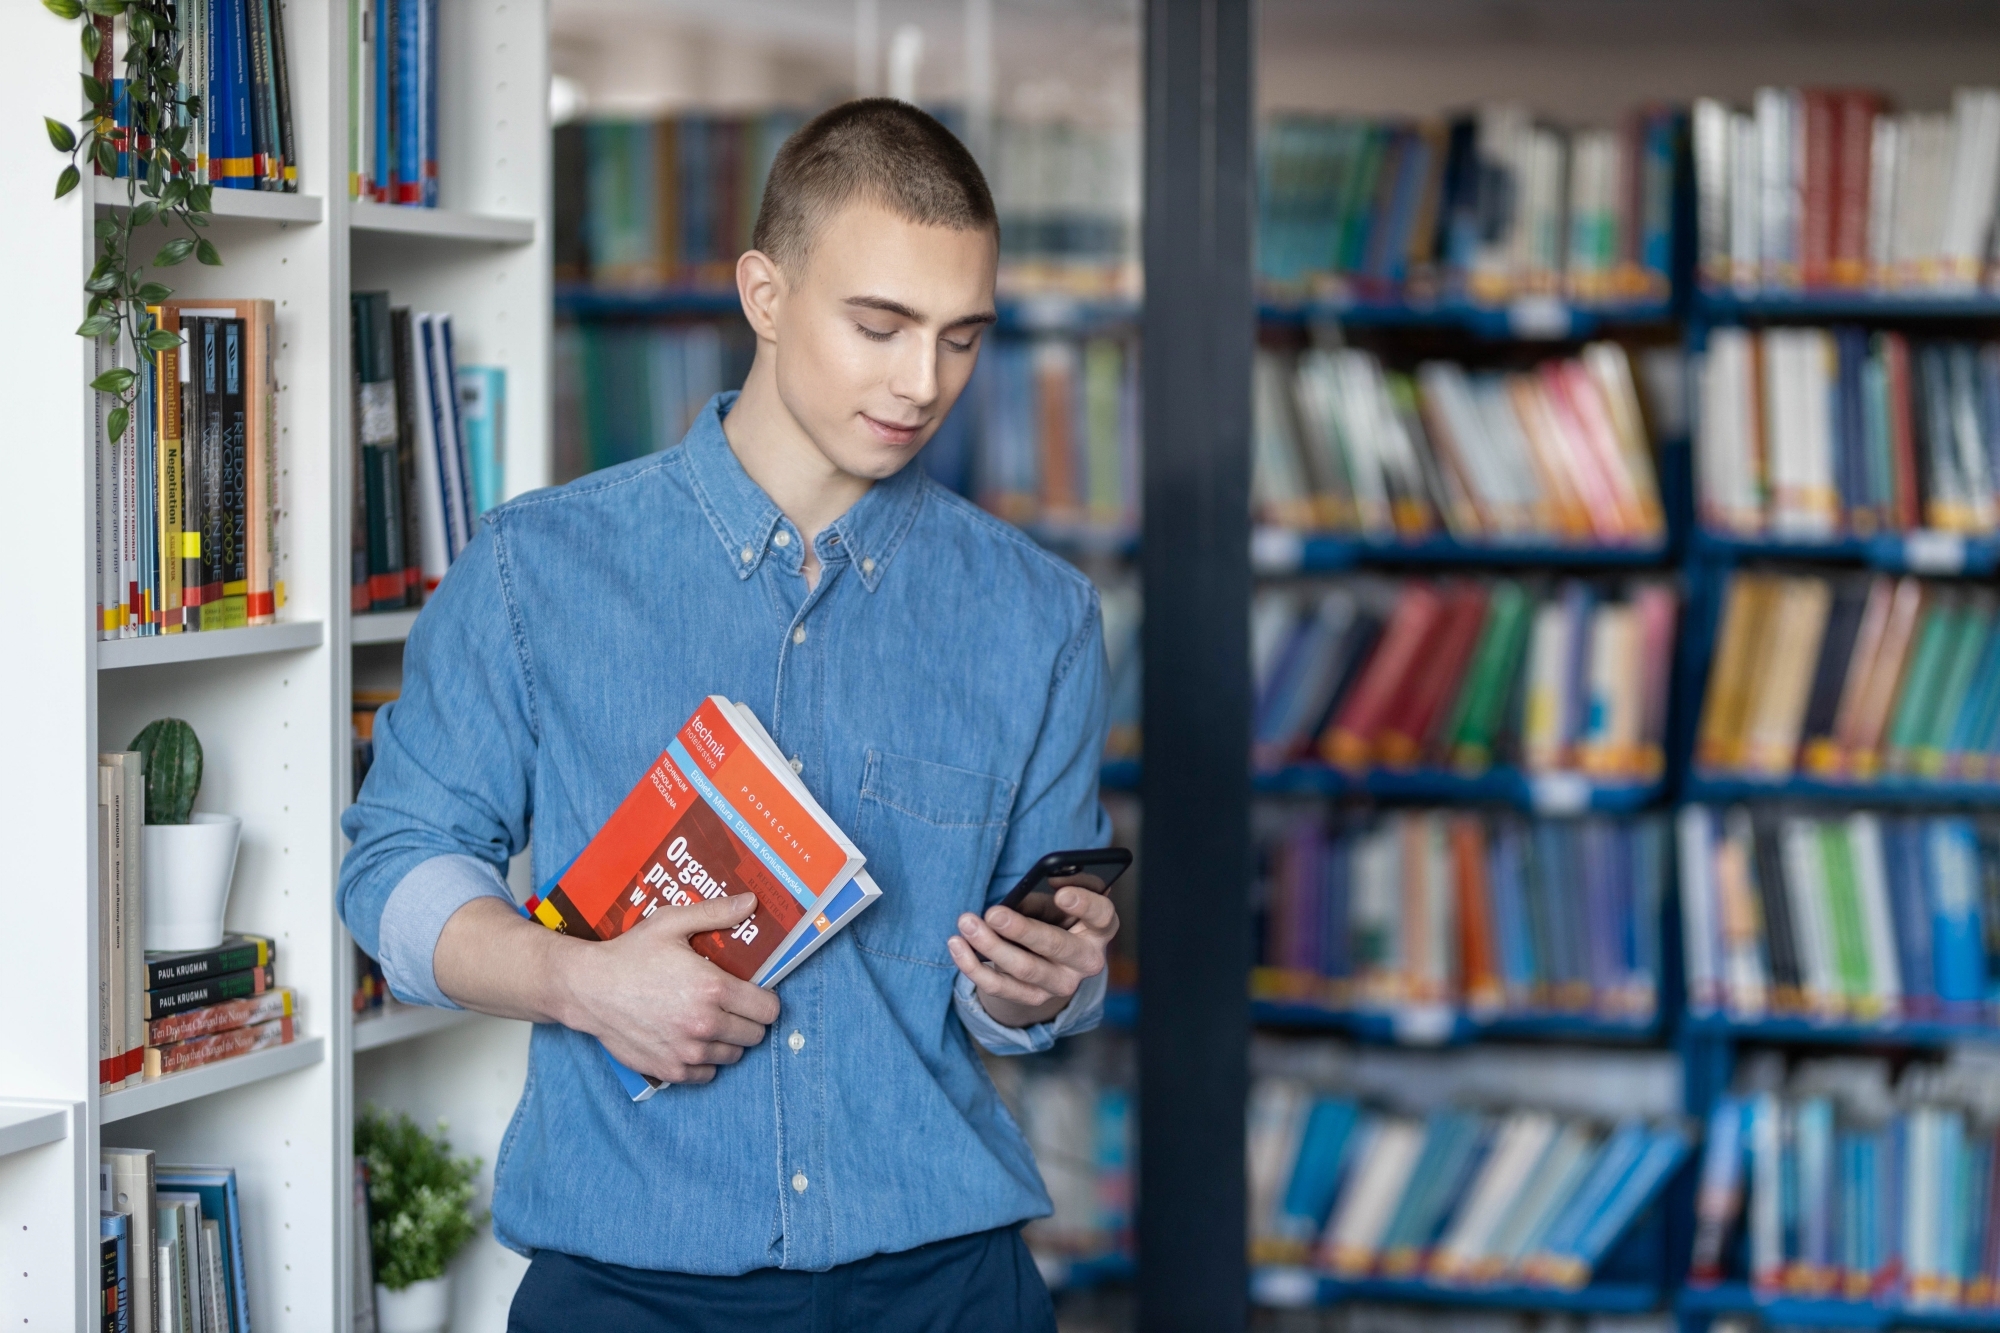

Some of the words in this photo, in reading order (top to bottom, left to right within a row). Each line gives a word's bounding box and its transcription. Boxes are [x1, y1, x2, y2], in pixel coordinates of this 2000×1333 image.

[253, 30, 262, 84] EUROPE
[260, 32, 270, 85] EUROPE
[167, 353, 176, 438] International
[131, 446, 135, 457] TO
[212, 411, 221, 509] FREEDOM
[223, 427, 233, 506] WORLD
[234, 411, 244, 509] FREEDOM
[167, 449, 177, 524] Negotiation
[203, 512, 212, 566] 2009
[212, 515, 222, 536] IN
[223, 511, 234, 564] 2009
[235, 514, 244, 536] IN
[212, 544, 222, 582] THE
[235, 543, 245, 580] THE
[685, 727, 717, 770] hotelarstwa
[691, 715, 726, 762] technik
[650, 773, 677, 810] POLICEALNA
[655, 766, 673, 791] SZKOŁA
[663, 758, 688, 793] TECHNIKUM
[690, 769, 713, 798] Elżbieta
[713, 796, 734, 821] Mitura
[735, 820, 760, 849] Elżbieta
[760, 847, 802, 894] Koniuszewska
[741, 786, 811, 862] PODRĘCZNIK
[630, 886, 647, 907] w
[666, 836, 758, 945] Organija
[756, 872, 790, 911] RECEPCJA
[816, 917, 826, 927] 2
[158, 969, 175, 980] PAUL
[176, 961, 208, 976] KRUGMAN
[159, 997, 176, 1008] PAUL
[178, 989, 208, 1004] KRUGMAN
[152, 1028, 164, 1039] Ten
[166, 1023, 180, 1038] Days
[180, 1021, 192, 1032] that
[192, 1017, 219, 1032] Changed
[219, 1014, 228, 1024] the
[163, 1056, 175, 1067] Ten
[176, 1052, 190, 1064] Days
[190, 1049, 201, 1059] that
[201, 1045, 224, 1059] Changed
[225, 1042, 234, 1051] the
[179, 1224, 187, 1299] Dictionary
